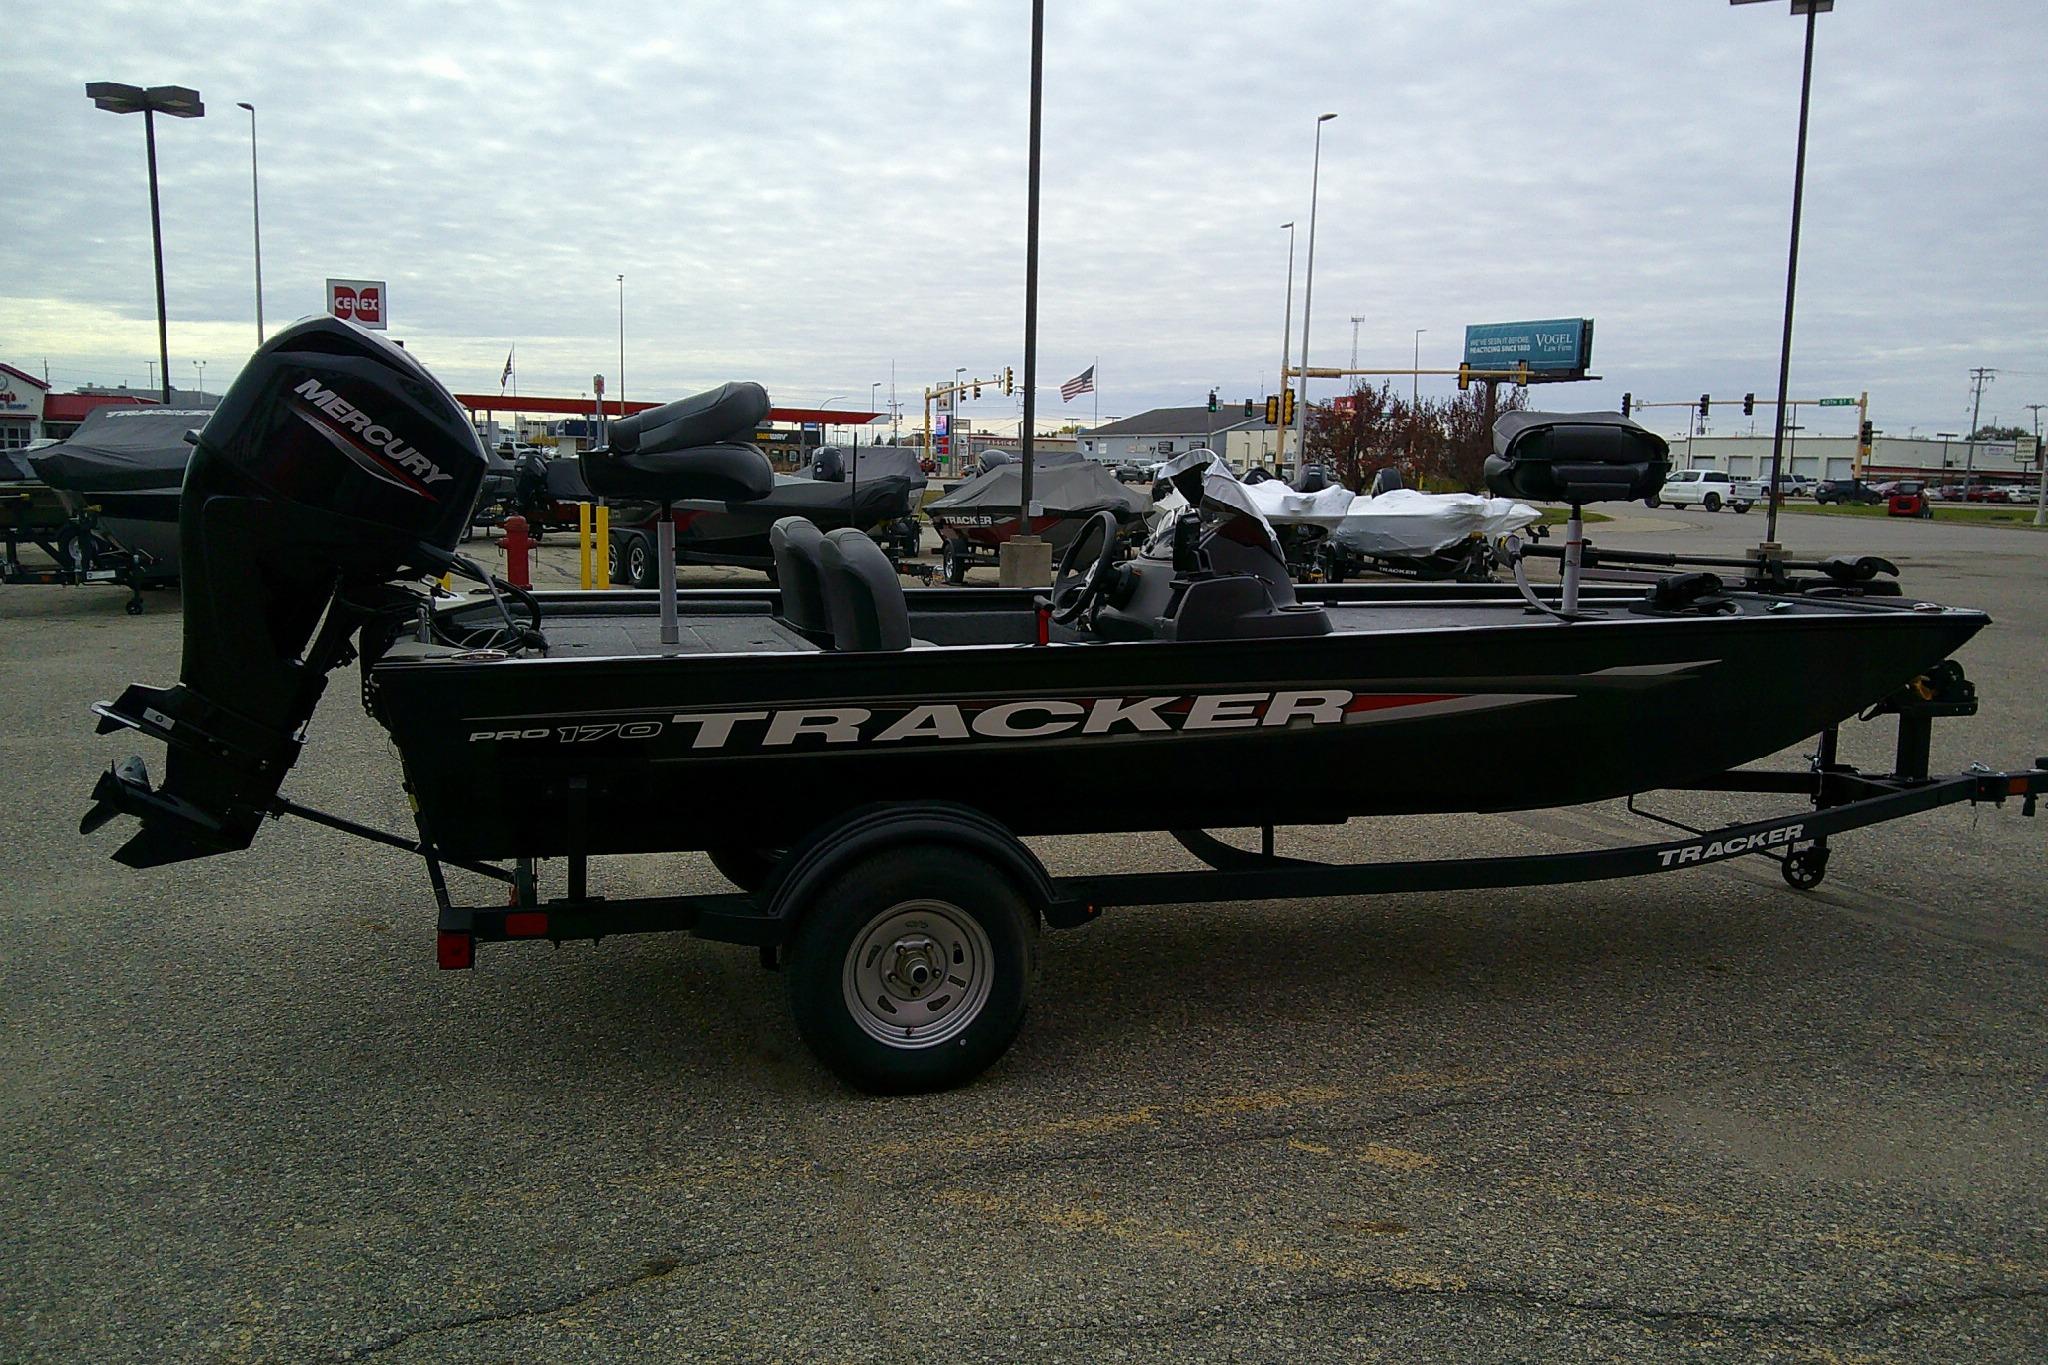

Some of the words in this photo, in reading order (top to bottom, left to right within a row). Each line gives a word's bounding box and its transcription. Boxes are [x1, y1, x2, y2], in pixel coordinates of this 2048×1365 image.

[335, 296, 378, 310] CENEX
[1536, 333, 1573, 347] VOGEL
[293, 378, 454, 484] MERCURY
[943, 516, 992, 525] TRACKER
[1379, 566, 1417, 576] TRACKER
[672, 690, 1353, 748] TRACKER
[469, 729, 550, 742] PRO
[557, 722, 663, 743] 170
[1657, 824, 1804, 867] TRACKER
